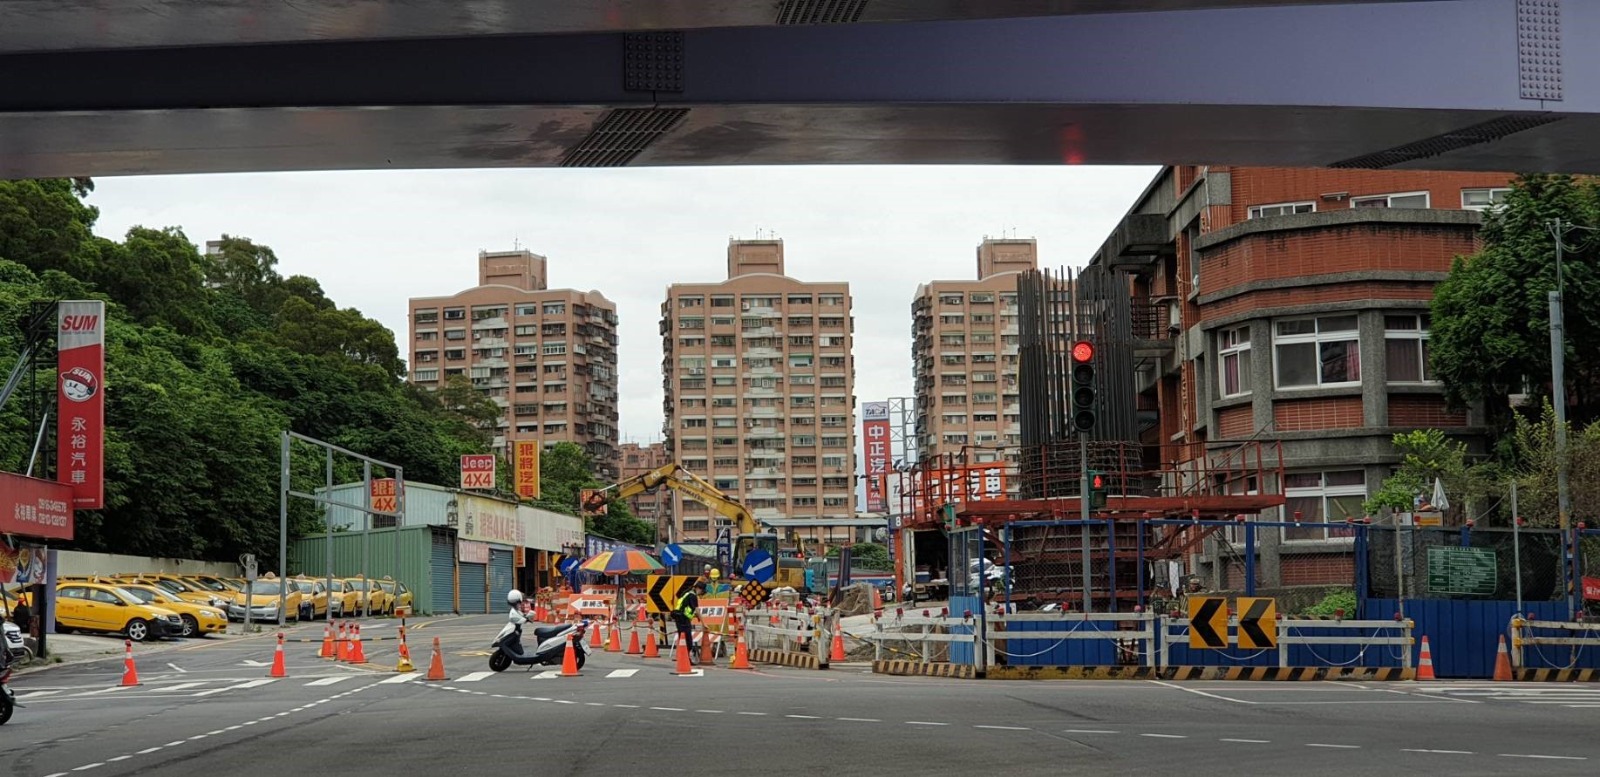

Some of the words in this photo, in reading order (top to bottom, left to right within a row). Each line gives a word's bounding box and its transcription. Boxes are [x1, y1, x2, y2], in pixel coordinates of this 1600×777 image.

[61, 315, 98, 331] SUM
[72, 368, 92, 383] SUM
[71, 417, 86, 484] 永裕汽車
[868, 424, 886, 489] 中正汽
[462, 457, 492, 469] Jeep
[463, 474, 491, 487] 4X4
[374, 497, 396, 511] 4X
